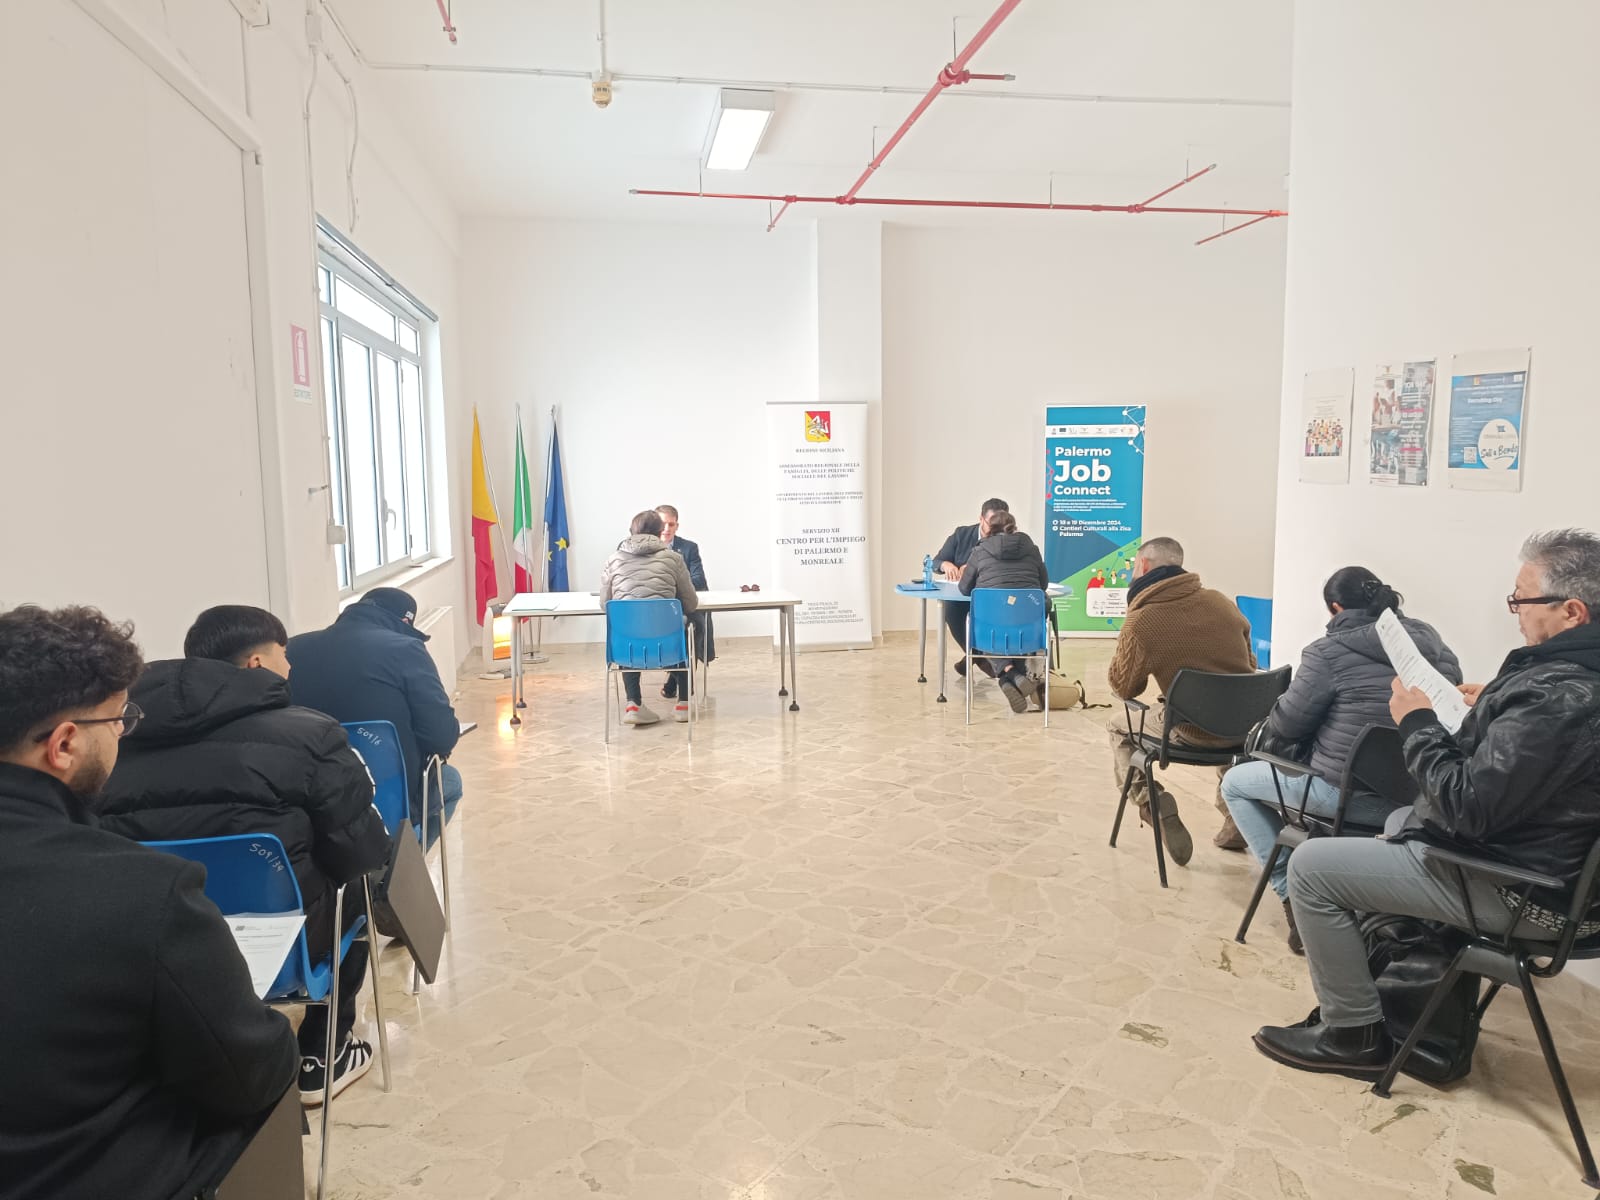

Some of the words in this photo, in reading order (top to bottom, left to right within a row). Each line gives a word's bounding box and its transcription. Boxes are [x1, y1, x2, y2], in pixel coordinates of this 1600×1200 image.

[1055, 446, 1112, 457] Palermo
[1054, 458, 1112, 482] Job
[1054, 485, 1111, 495] Connect
[776, 537, 807, 545] CENTRO
[805, 547, 842, 555] PALERMO
[800, 558, 844, 566] MONREALE
